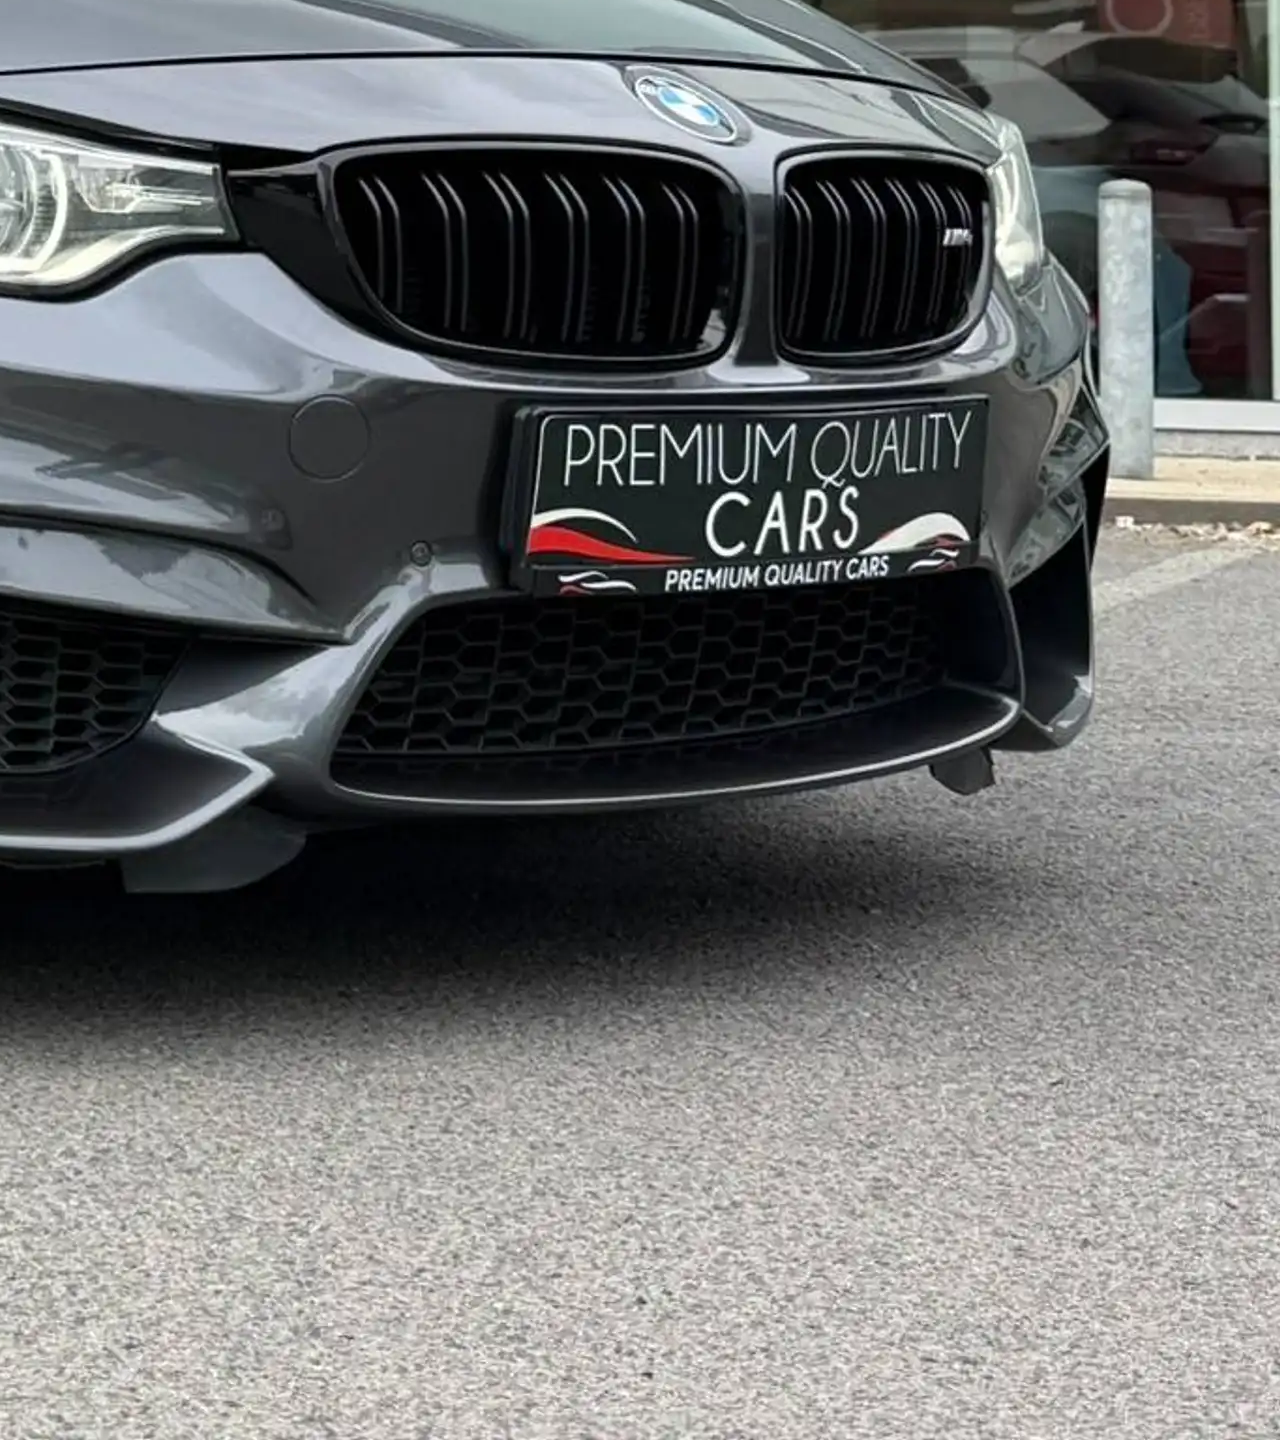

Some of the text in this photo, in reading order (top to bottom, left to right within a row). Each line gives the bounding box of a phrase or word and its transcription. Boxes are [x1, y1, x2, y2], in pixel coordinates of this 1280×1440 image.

[563, 411, 972, 492] PREMIUM QUALITY
[704, 486, 860, 556] CARS
[664, 554, 892, 593] PREMIUM QUALITY CARS
